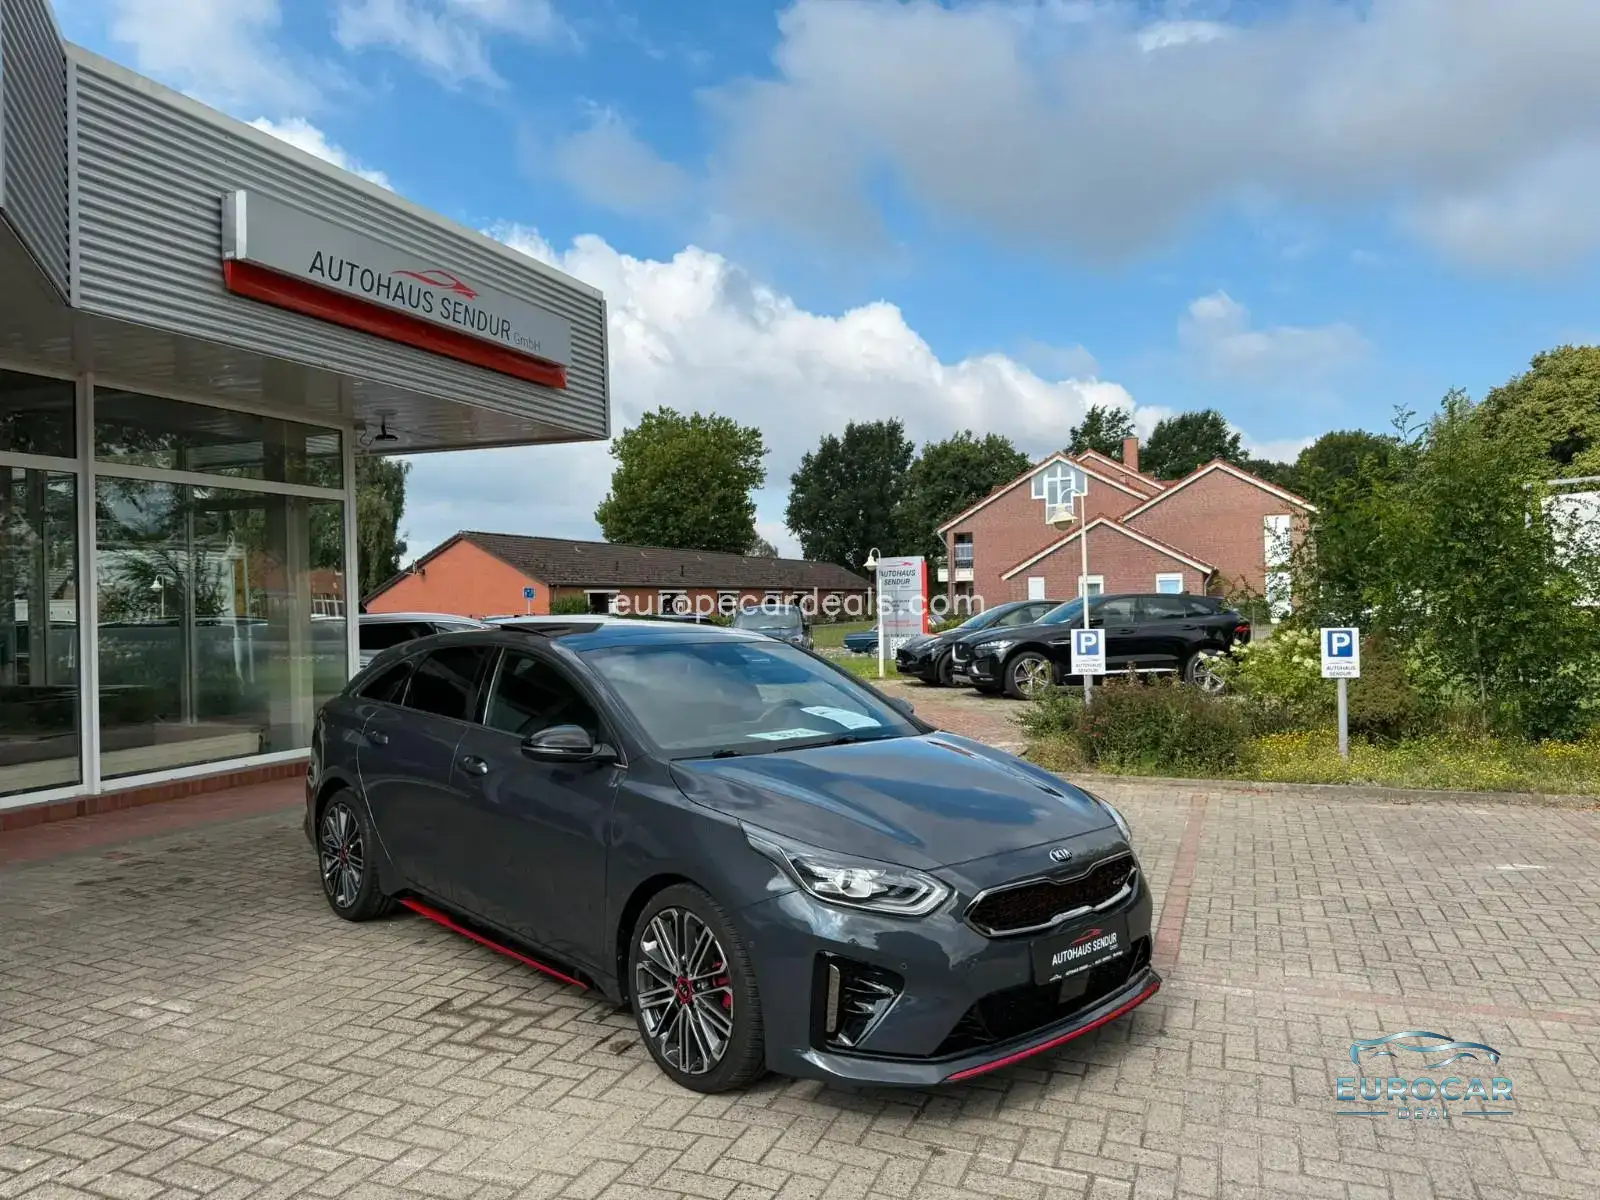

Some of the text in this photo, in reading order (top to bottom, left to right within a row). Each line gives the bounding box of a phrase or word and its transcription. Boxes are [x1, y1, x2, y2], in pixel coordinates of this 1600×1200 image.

[308, 250, 541, 351] AUTOHAUS SENDUR GmbH
[1080, 633, 1096, 653] P
[1331, 633, 1350, 655] P
[1052, 848, 1072, 861] KIA
[1051, 942, 1092, 967] AUTOHAUS
[1092, 932, 1117, 952] SENDUR
